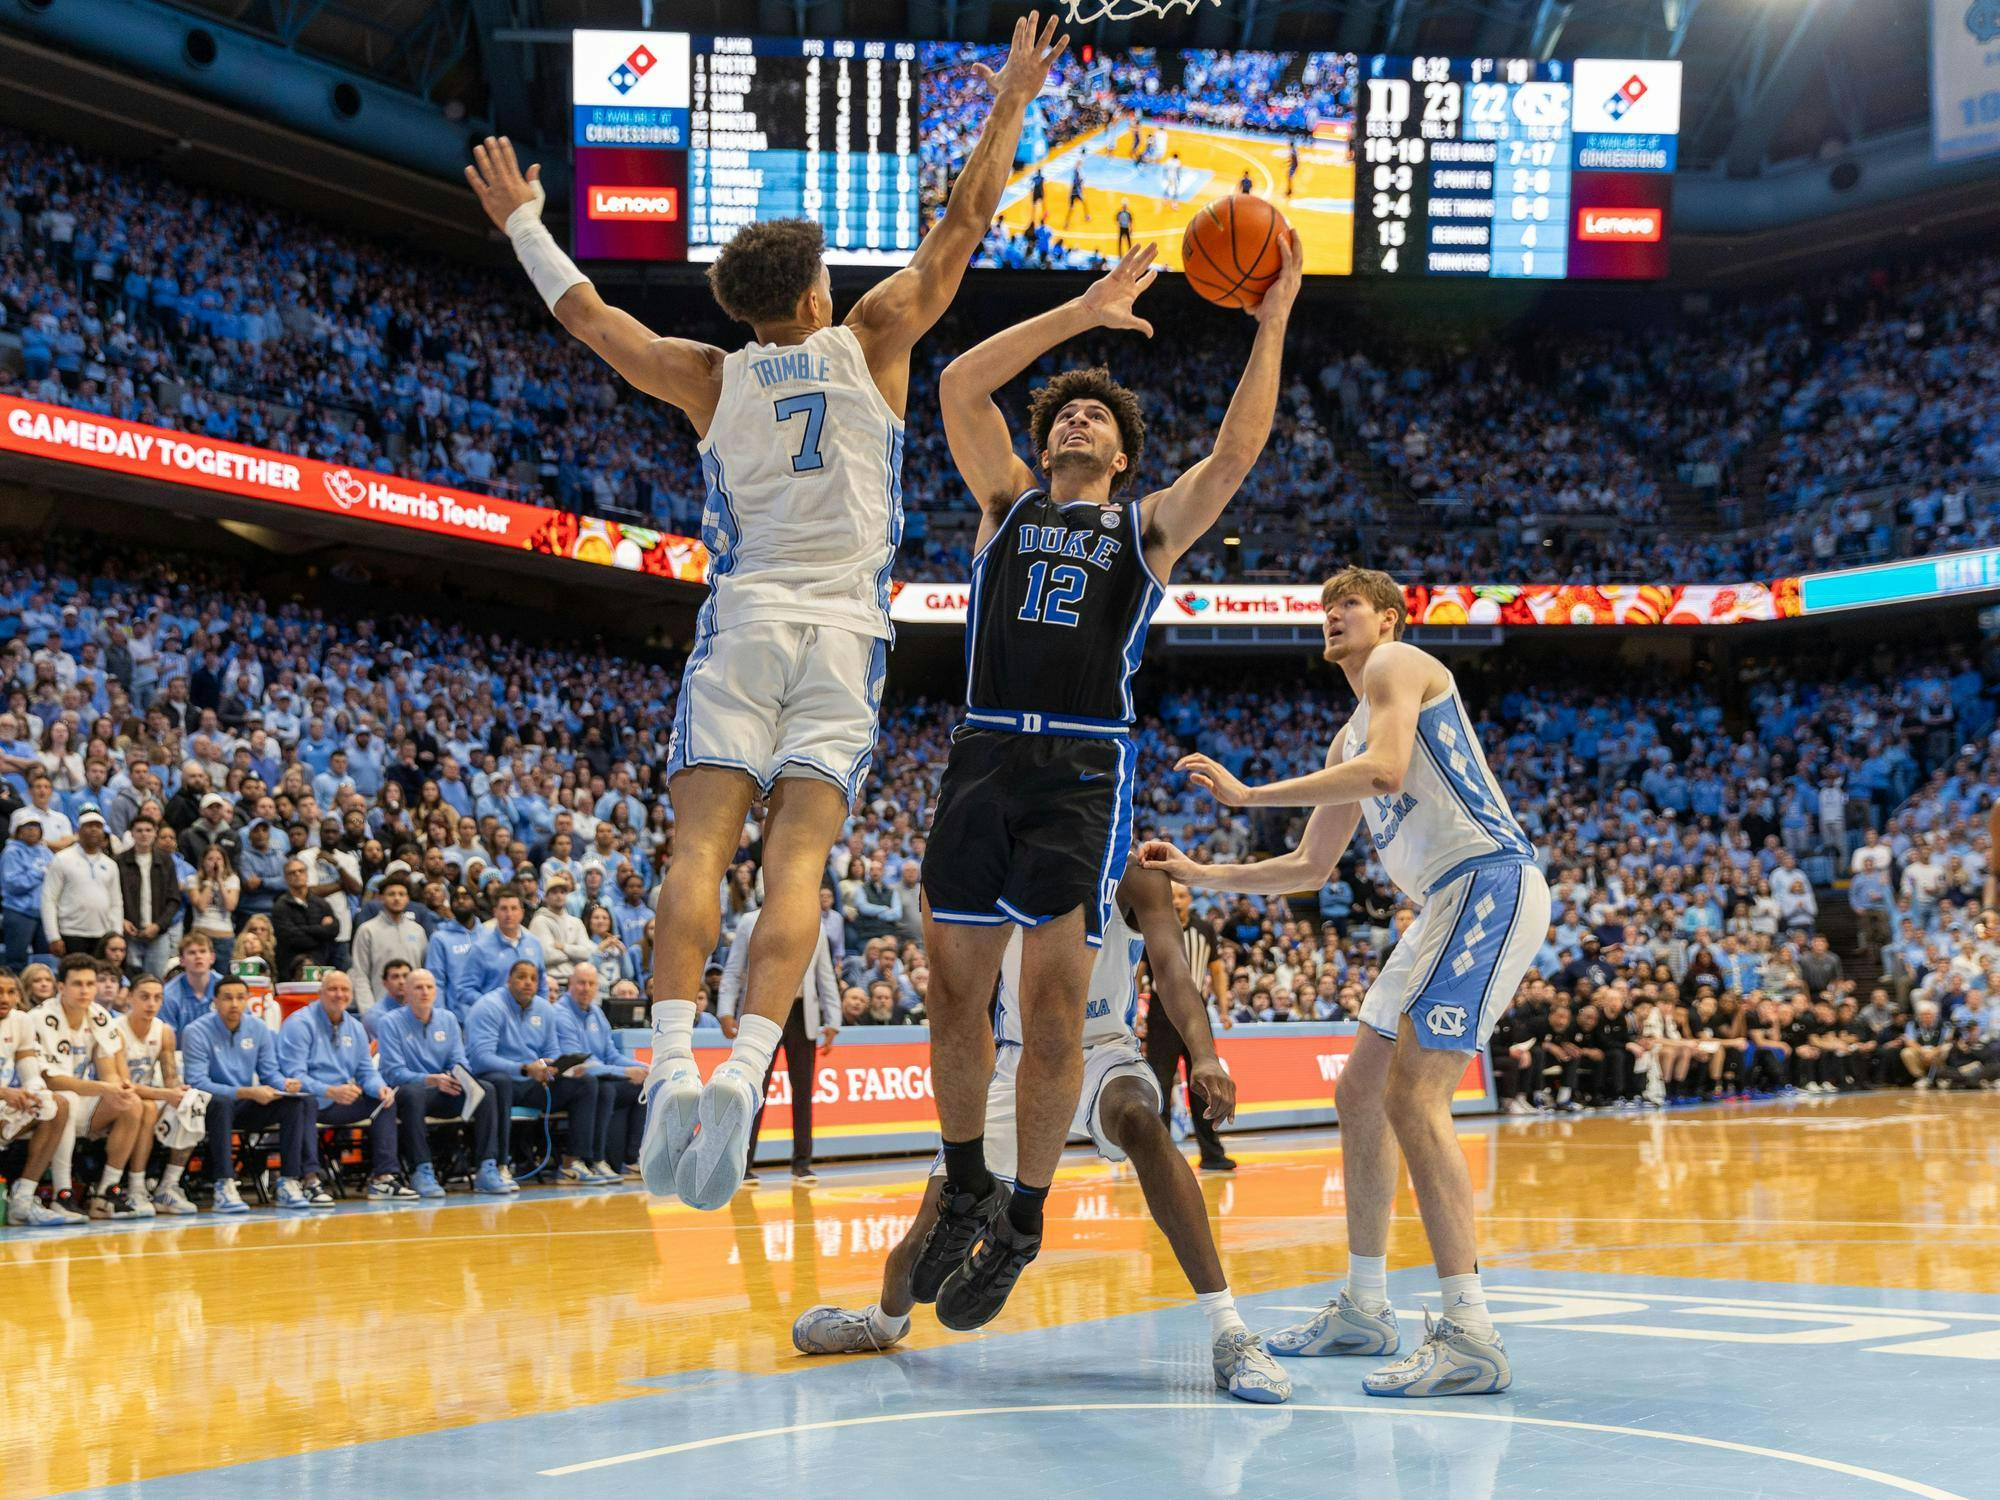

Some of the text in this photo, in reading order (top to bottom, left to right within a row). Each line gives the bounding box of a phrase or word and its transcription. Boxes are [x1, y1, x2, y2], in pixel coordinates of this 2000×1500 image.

[1423, 82, 1461, 122] 23
[1471, 83, 1508, 123] 22
[585, 124, 680, 144] CONCESSIONS
[1509, 141, 1556, 166] 7-17
[596, 191, 670, 214] Lenovo
[1372, 192, 1412, 219] 3-4
[1378, 220, 1406, 246] 15
[1520, 224, 1538, 249] 4
[1585, 213, 1655, 234] Lenovo
[1381, 248, 1399, 273] 4
[1521, 251, 1534, 276] 1
[749, 352, 831, 388] TRIMBLE
[773, 391, 827, 472] 7
[8, 408, 301, 492] GAMEDAY TOGETHER
[368, 481, 510, 534] Harris Teeter
[1018, 524, 1122, 571] DUKE
[1017, 560, 1088, 627] 12
[1215, 595, 1279, 613] Harris
[1022, 713, 1042, 732] D
